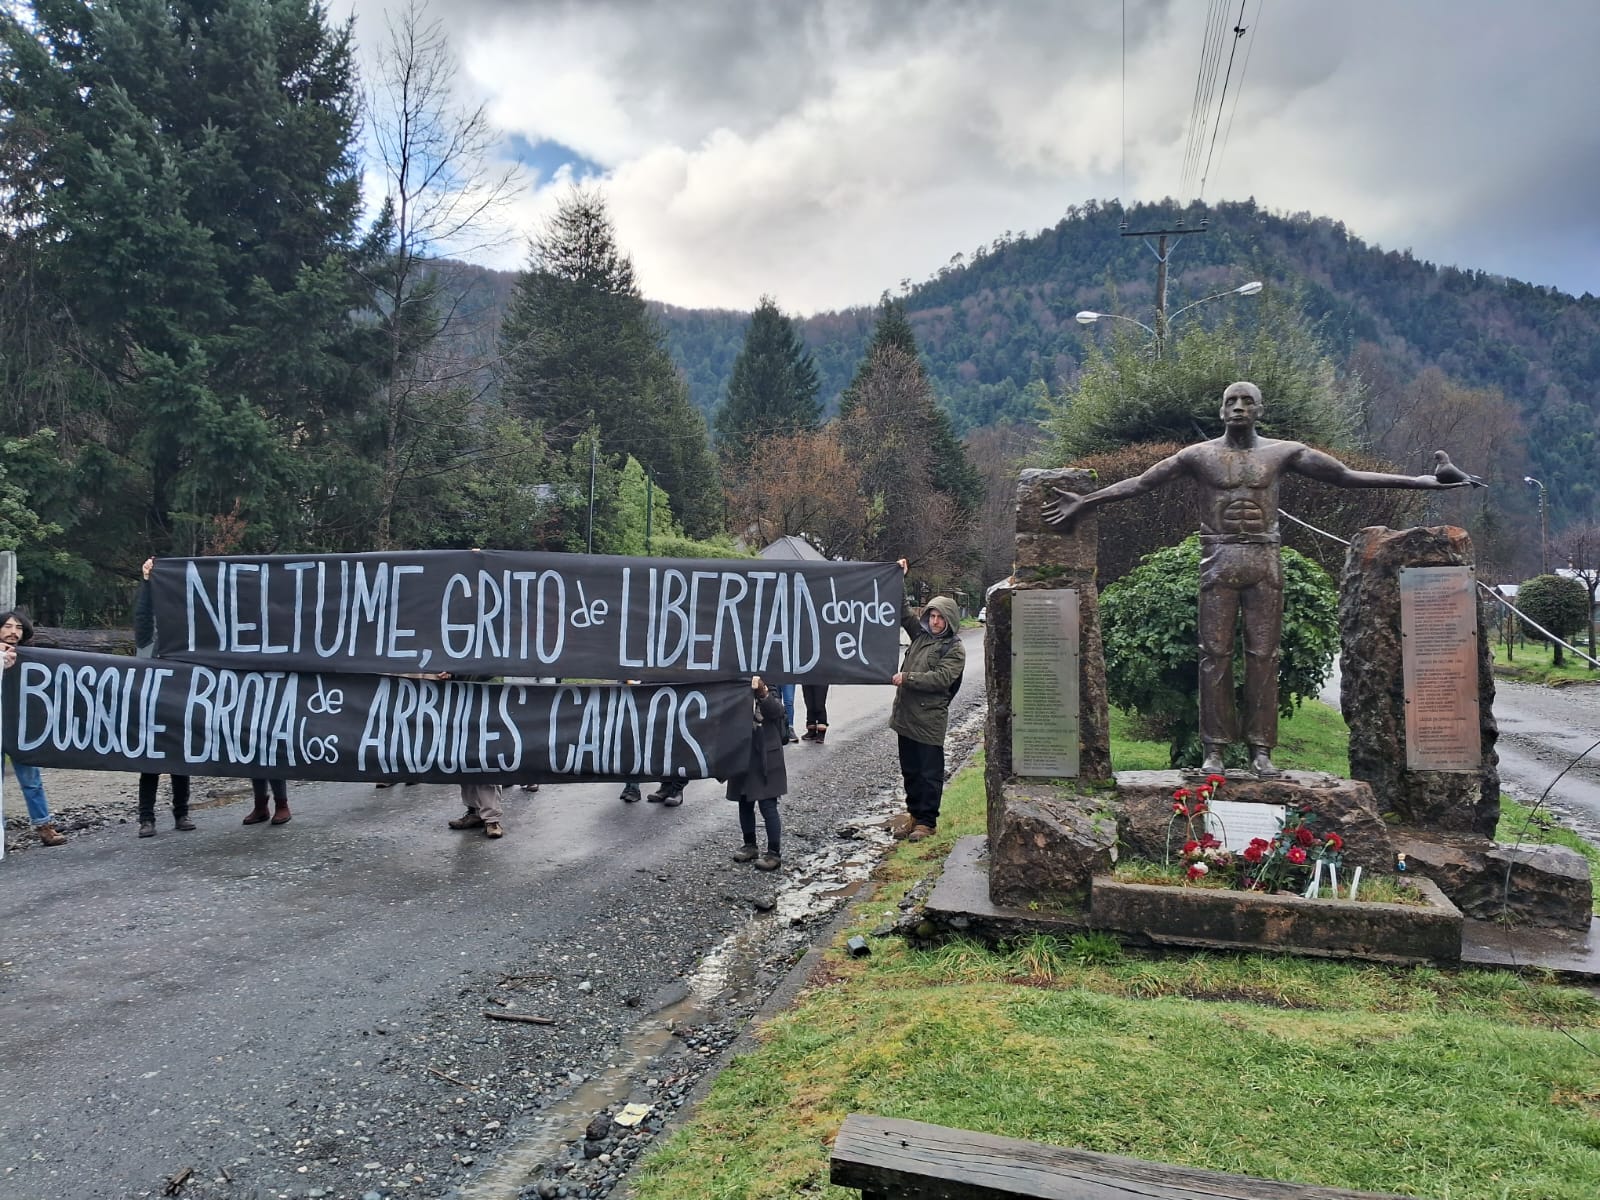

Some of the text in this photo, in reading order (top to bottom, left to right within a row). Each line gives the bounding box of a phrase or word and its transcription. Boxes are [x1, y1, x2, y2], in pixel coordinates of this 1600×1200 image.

[186, 561, 896, 674] NELTUME, GRITO de LIBERTAD donde el
[18, 662, 173, 758] BOSQUE
[184, 667, 297, 766] BROTA
[300, 716, 339, 764] los
[307, 673, 344, 713] de
